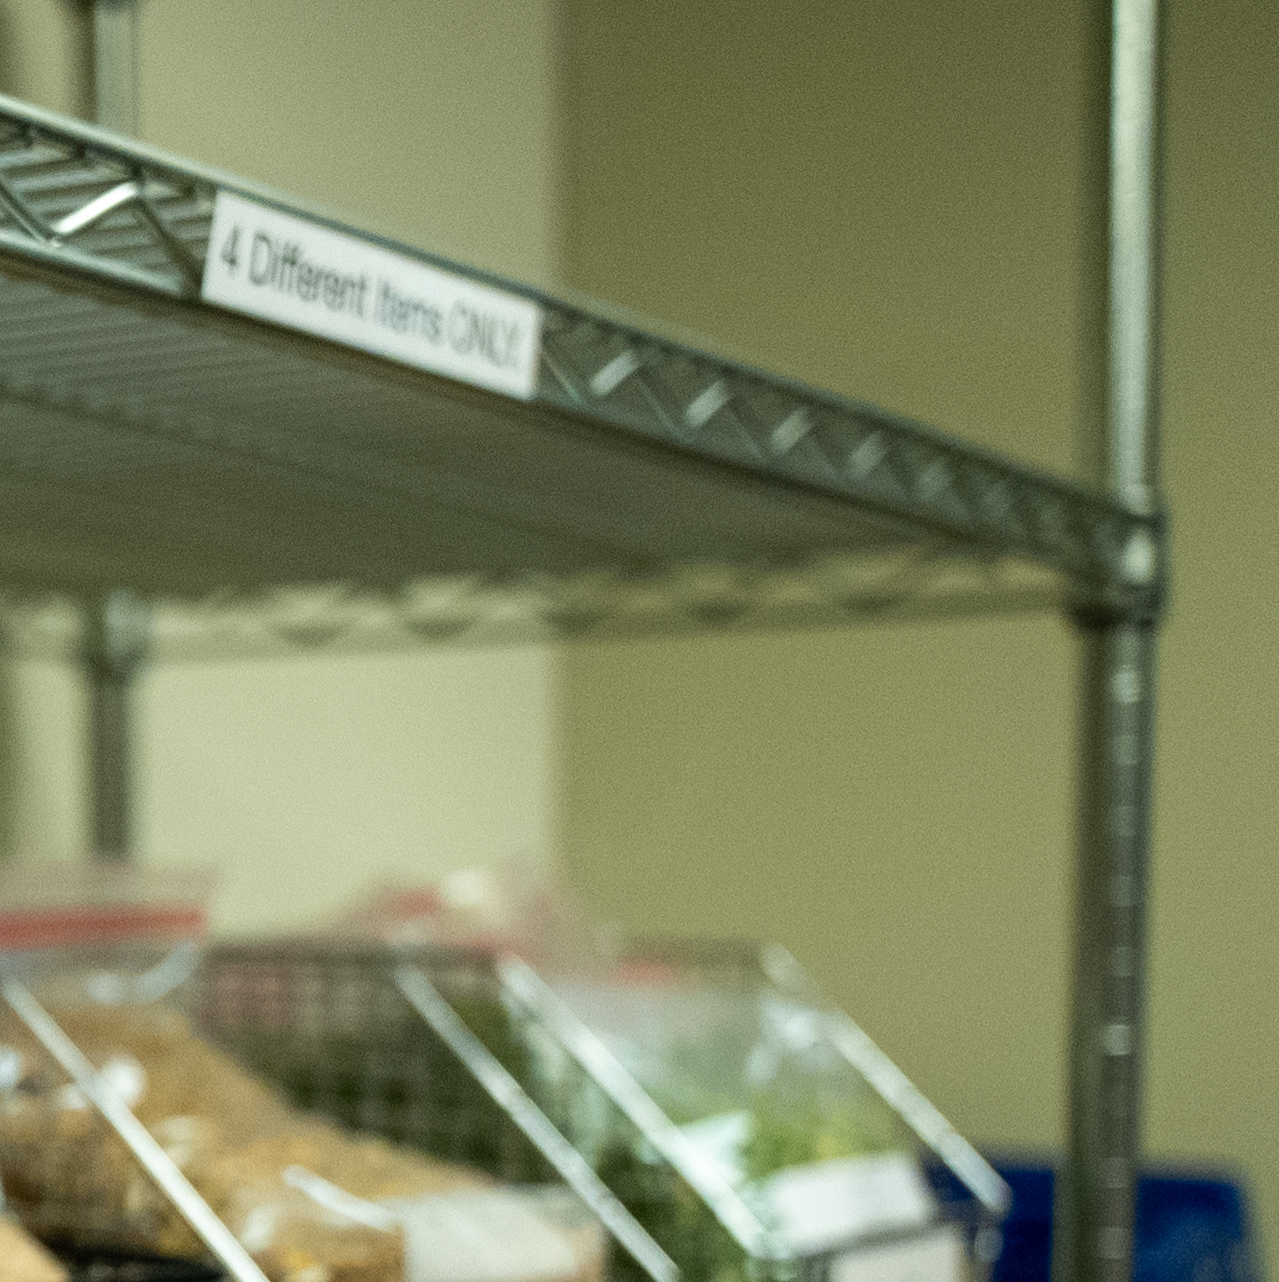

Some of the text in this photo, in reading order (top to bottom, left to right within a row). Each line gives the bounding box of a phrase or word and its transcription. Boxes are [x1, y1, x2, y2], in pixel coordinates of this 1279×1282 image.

[220, 225, 241, 275] 4
[248, 230, 369, 318] Different
[376, 276, 443, 344] Items
